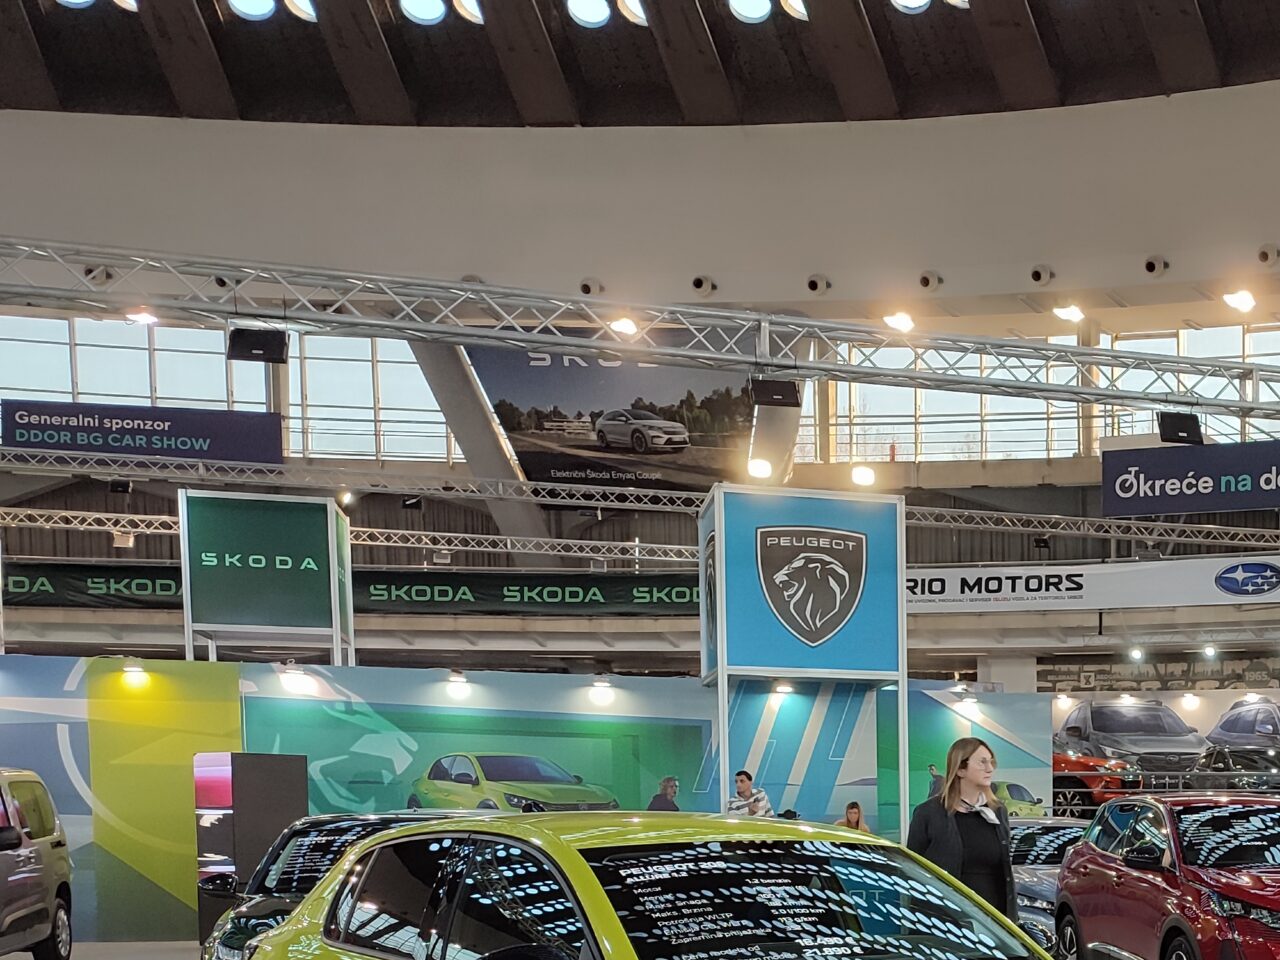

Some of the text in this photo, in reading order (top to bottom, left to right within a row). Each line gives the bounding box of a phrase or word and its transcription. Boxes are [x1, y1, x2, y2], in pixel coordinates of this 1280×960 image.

[15, 410, 171, 432] Generalni sponzor
[15, 429, 211, 451] DDOR BG CAR SHOW
[611, 471, 636, 480] Enyaq
[1115, 466, 1214, 498] Okreće
[1220, 473, 1252, 493] na
[766, 537, 856, 551] PEUGEOT
[87, 577, 183, 596] SKOD
[960, 573, 1084, 595] MOTORS
[619, 861, 728, 877] PEUGEOT 208
[625, 873, 671, 884] ALLURE
[633, 886, 662, 895] Motor
[682, 907, 713, 915] Brzina
[704, 912, 733, 921] WLTP
